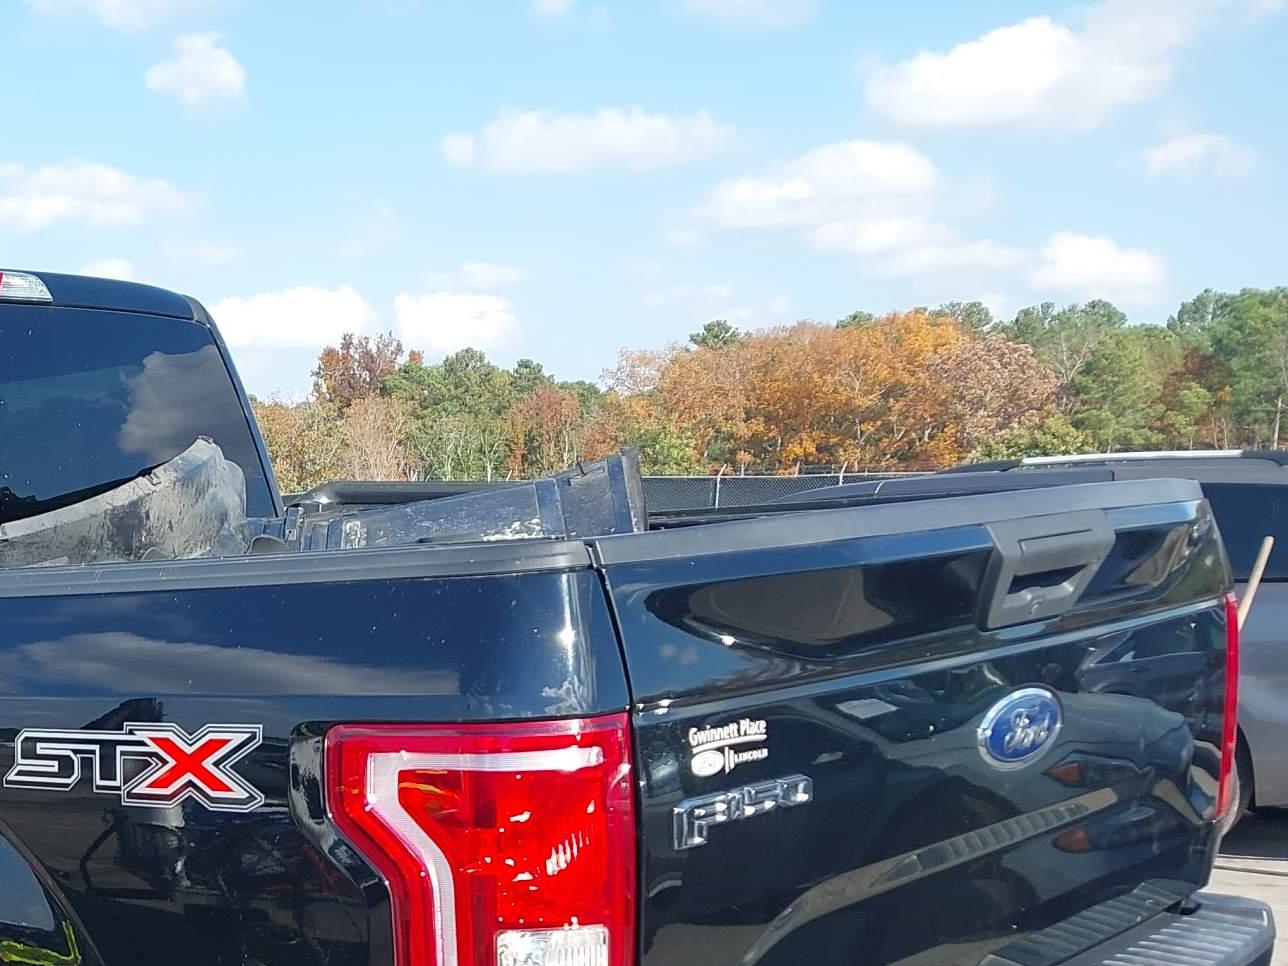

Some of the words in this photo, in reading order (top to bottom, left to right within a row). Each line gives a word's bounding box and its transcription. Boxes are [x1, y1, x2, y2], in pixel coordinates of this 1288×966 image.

[688, 724, 739, 747] Gwinnett
[739, 717, 768, 736] Place
[1003, 706, 1052, 754] Ford
[2, 722, 265, 813] STX
[734, 748, 769, 764] LINCOLN
